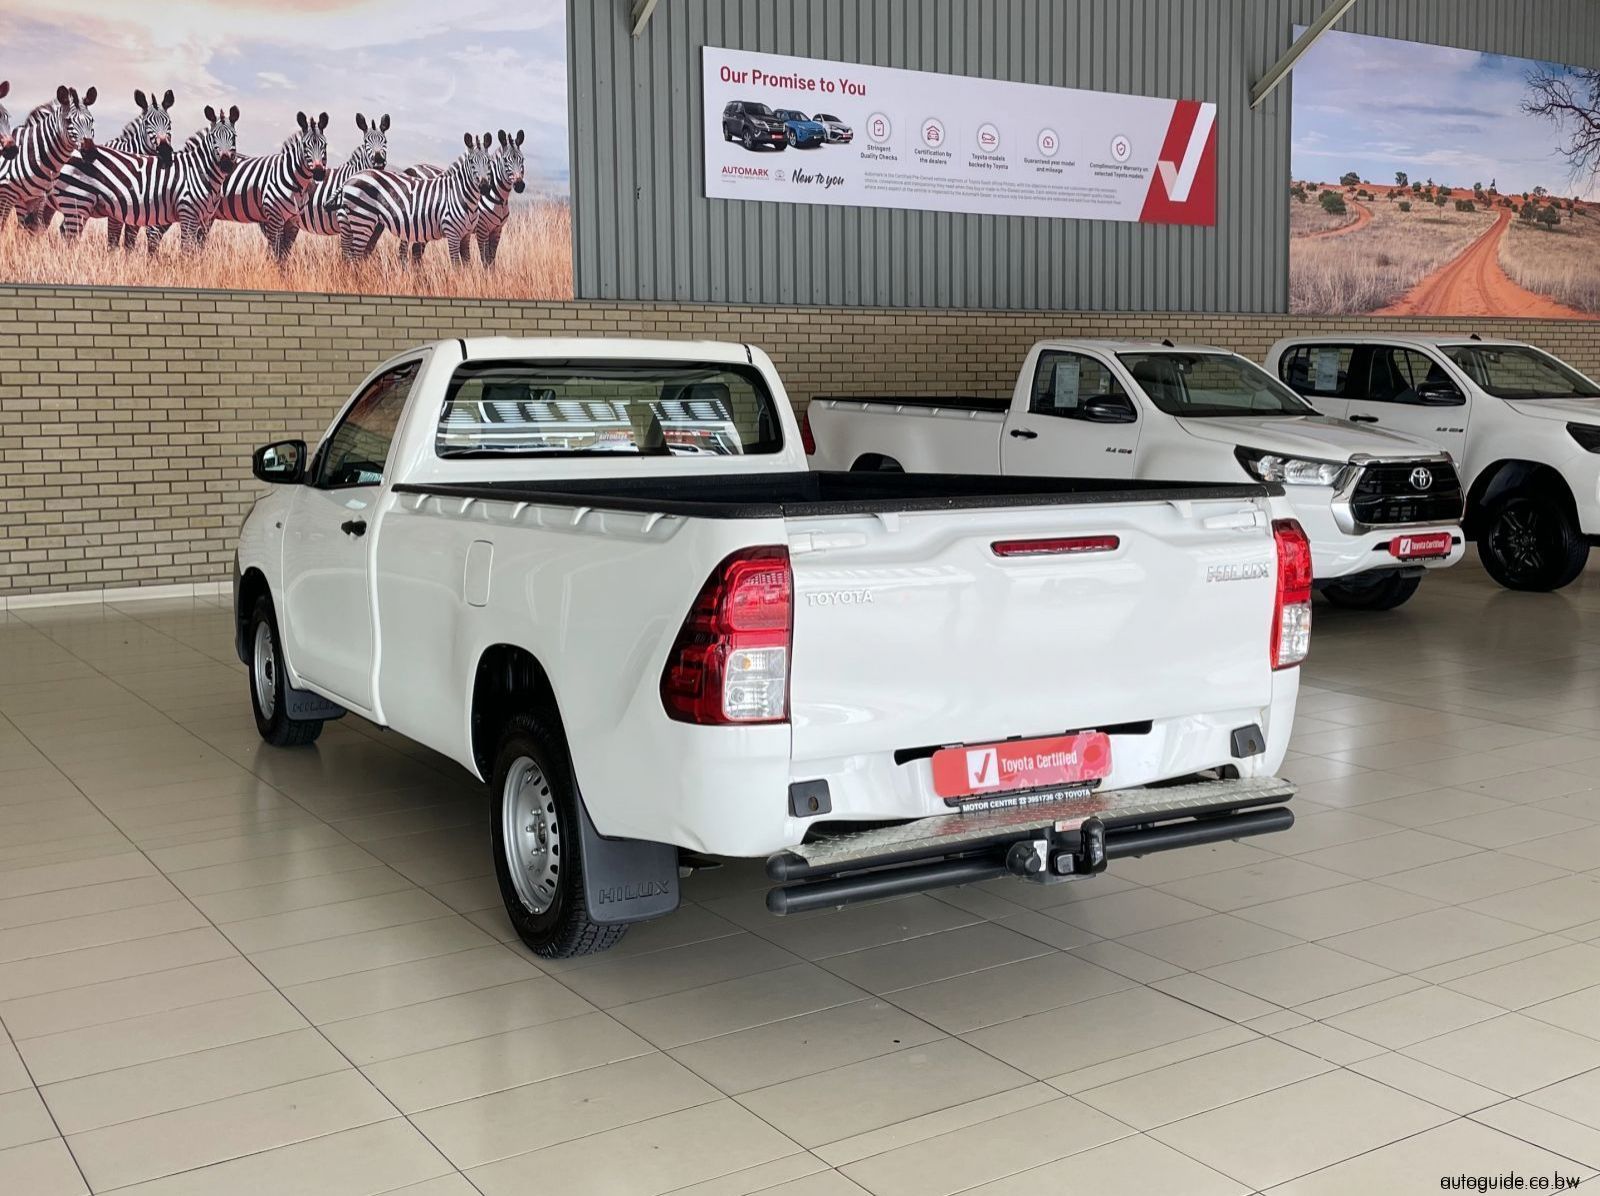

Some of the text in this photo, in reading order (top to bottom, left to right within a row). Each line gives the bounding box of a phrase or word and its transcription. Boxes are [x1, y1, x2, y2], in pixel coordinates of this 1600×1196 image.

[720, 66, 866, 96] Our Promise to You
[860, 152, 878, 160] Quality
[914, 148, 945, 157] Certification
[972, 153, 988, 161] Toyota
[722, 166, 769, 177] AUTOMARK
[792, 168, 845, 189] New to you
[1114, 171, 1128, 179] Toyota
[1206, 562, 1269, 582] HILUX
[806, 588, 873, 606] TOYOTA
[1001, 751, 1078, 773] Toyota Certified
[962, 801, 989, 811] MOTOR
[990, 798, 1018, 808] CENTRE
[1065, 789, 1091, 799] TOYOTA
[599, 880, 670, 904] HILUX
